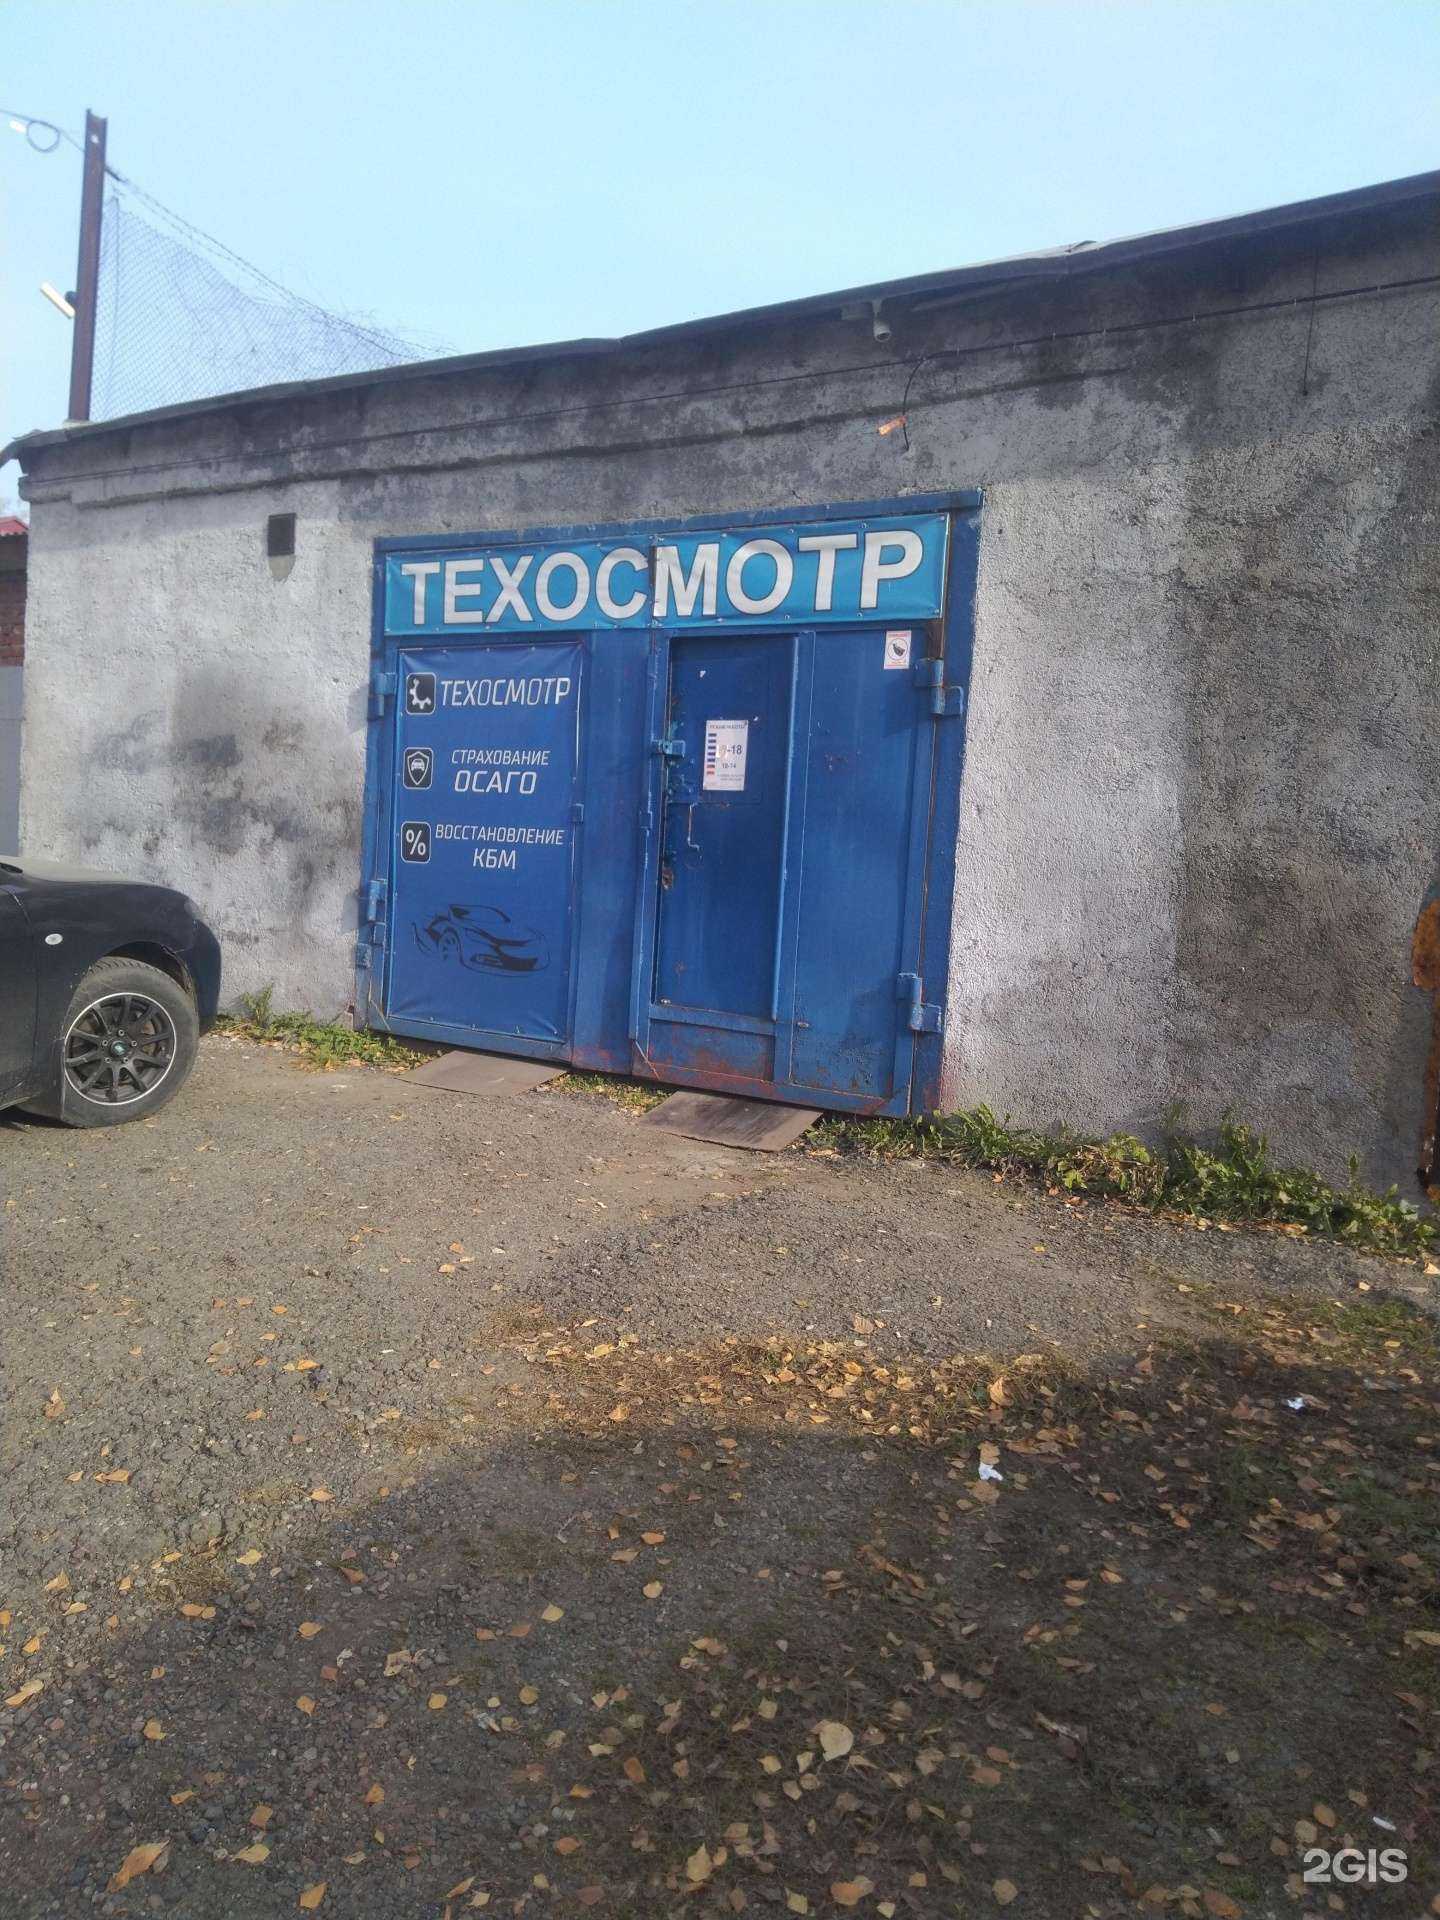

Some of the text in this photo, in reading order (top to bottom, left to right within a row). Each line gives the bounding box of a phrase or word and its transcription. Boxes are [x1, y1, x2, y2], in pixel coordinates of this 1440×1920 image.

[401, 530, 923, 625] ТЕХОСМОТР
[440, 677, 571, 707] ТЕХОСМОТР
[451, 749, 550, 766] СТРАХОВАНИЕ
[454, 769, 538, 795] ОСАГО
[435, 824, 565, 845] ВОССТАНОВЛЕНИЕ
[472, 848, 517, 870] КБМ
